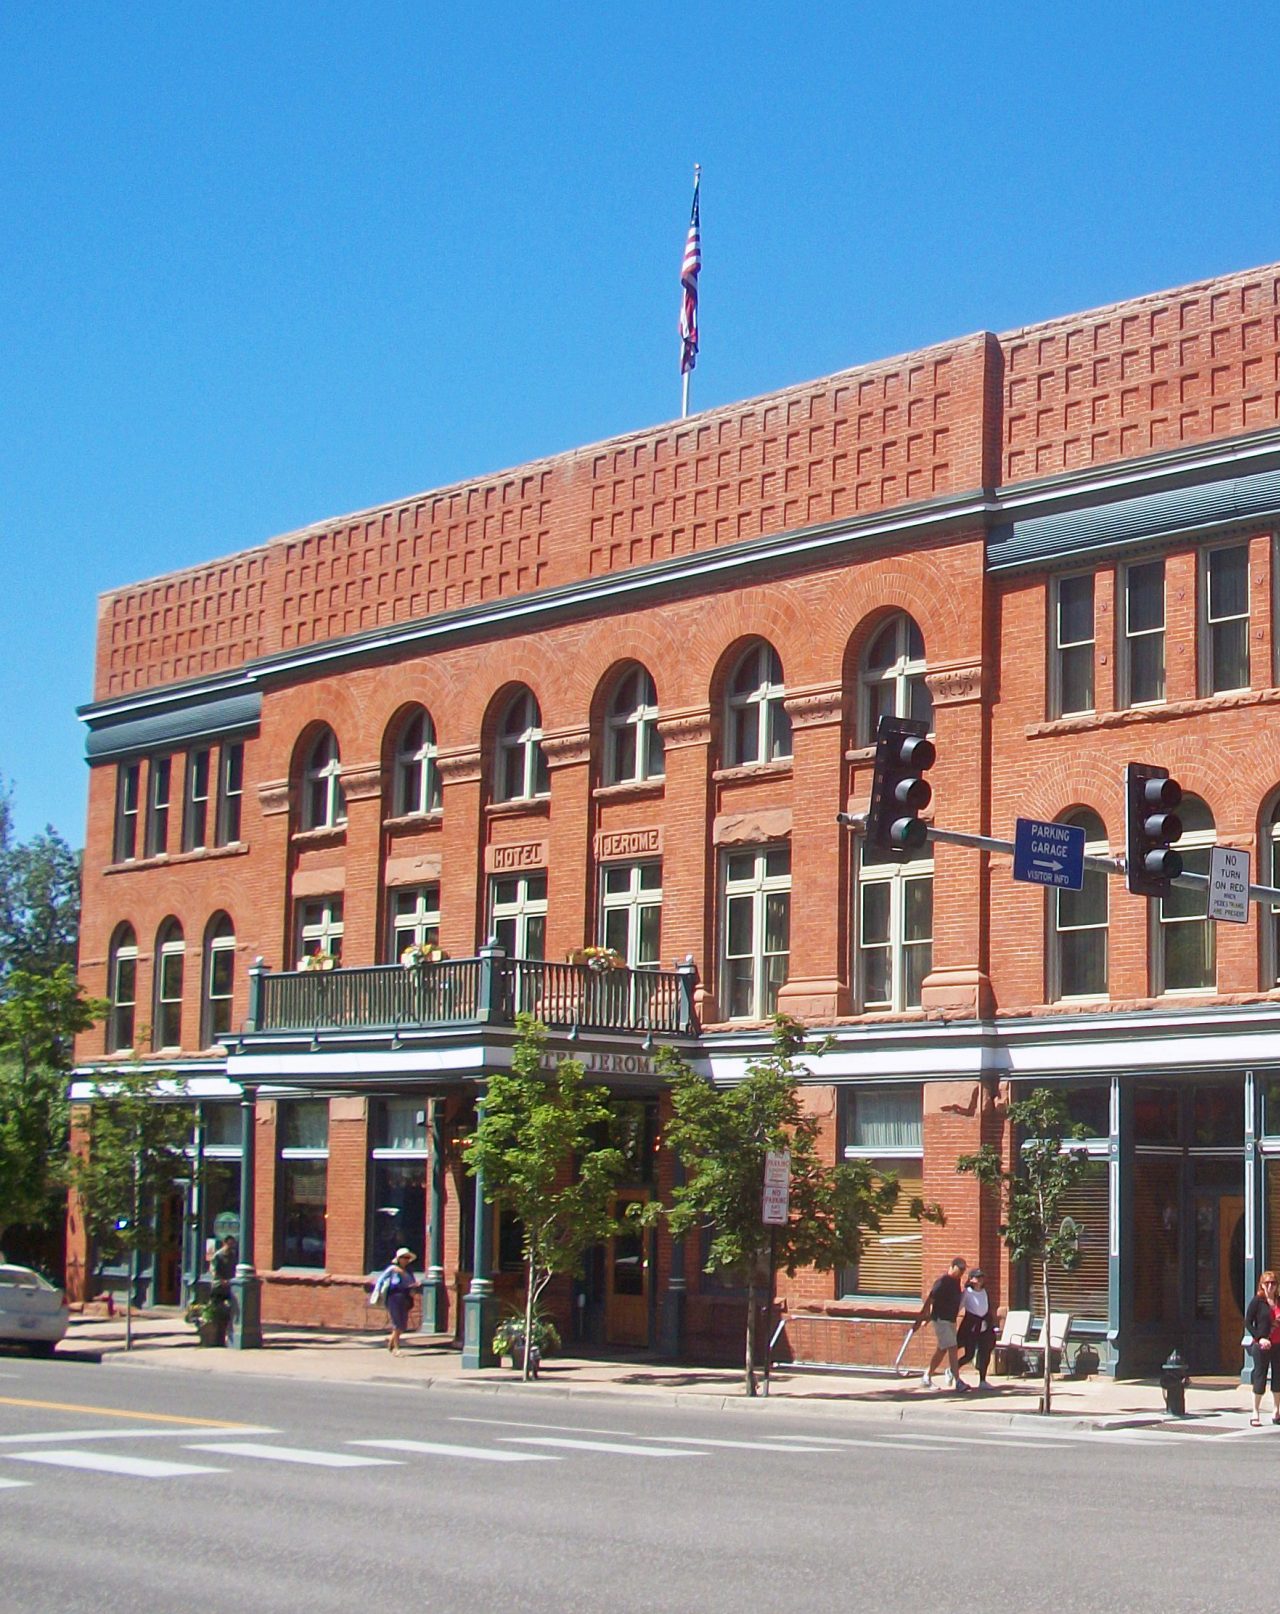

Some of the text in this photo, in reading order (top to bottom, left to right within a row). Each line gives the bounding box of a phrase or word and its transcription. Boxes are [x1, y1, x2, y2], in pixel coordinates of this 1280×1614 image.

[1031, 824, 1070, 842] PARKING
[603, 830, 659, 856] JEROME
[1031, 840, 1068, 858] GARAGE
[495, 845, 542, 868] HOTEL
[1225, 854, 1237, 866] NO
[1027, 869, 1070, 885] VISITOR INFO
[1221, 868, 1241, 880] TURN
[1215, 880, 1245, 893] ON RED
